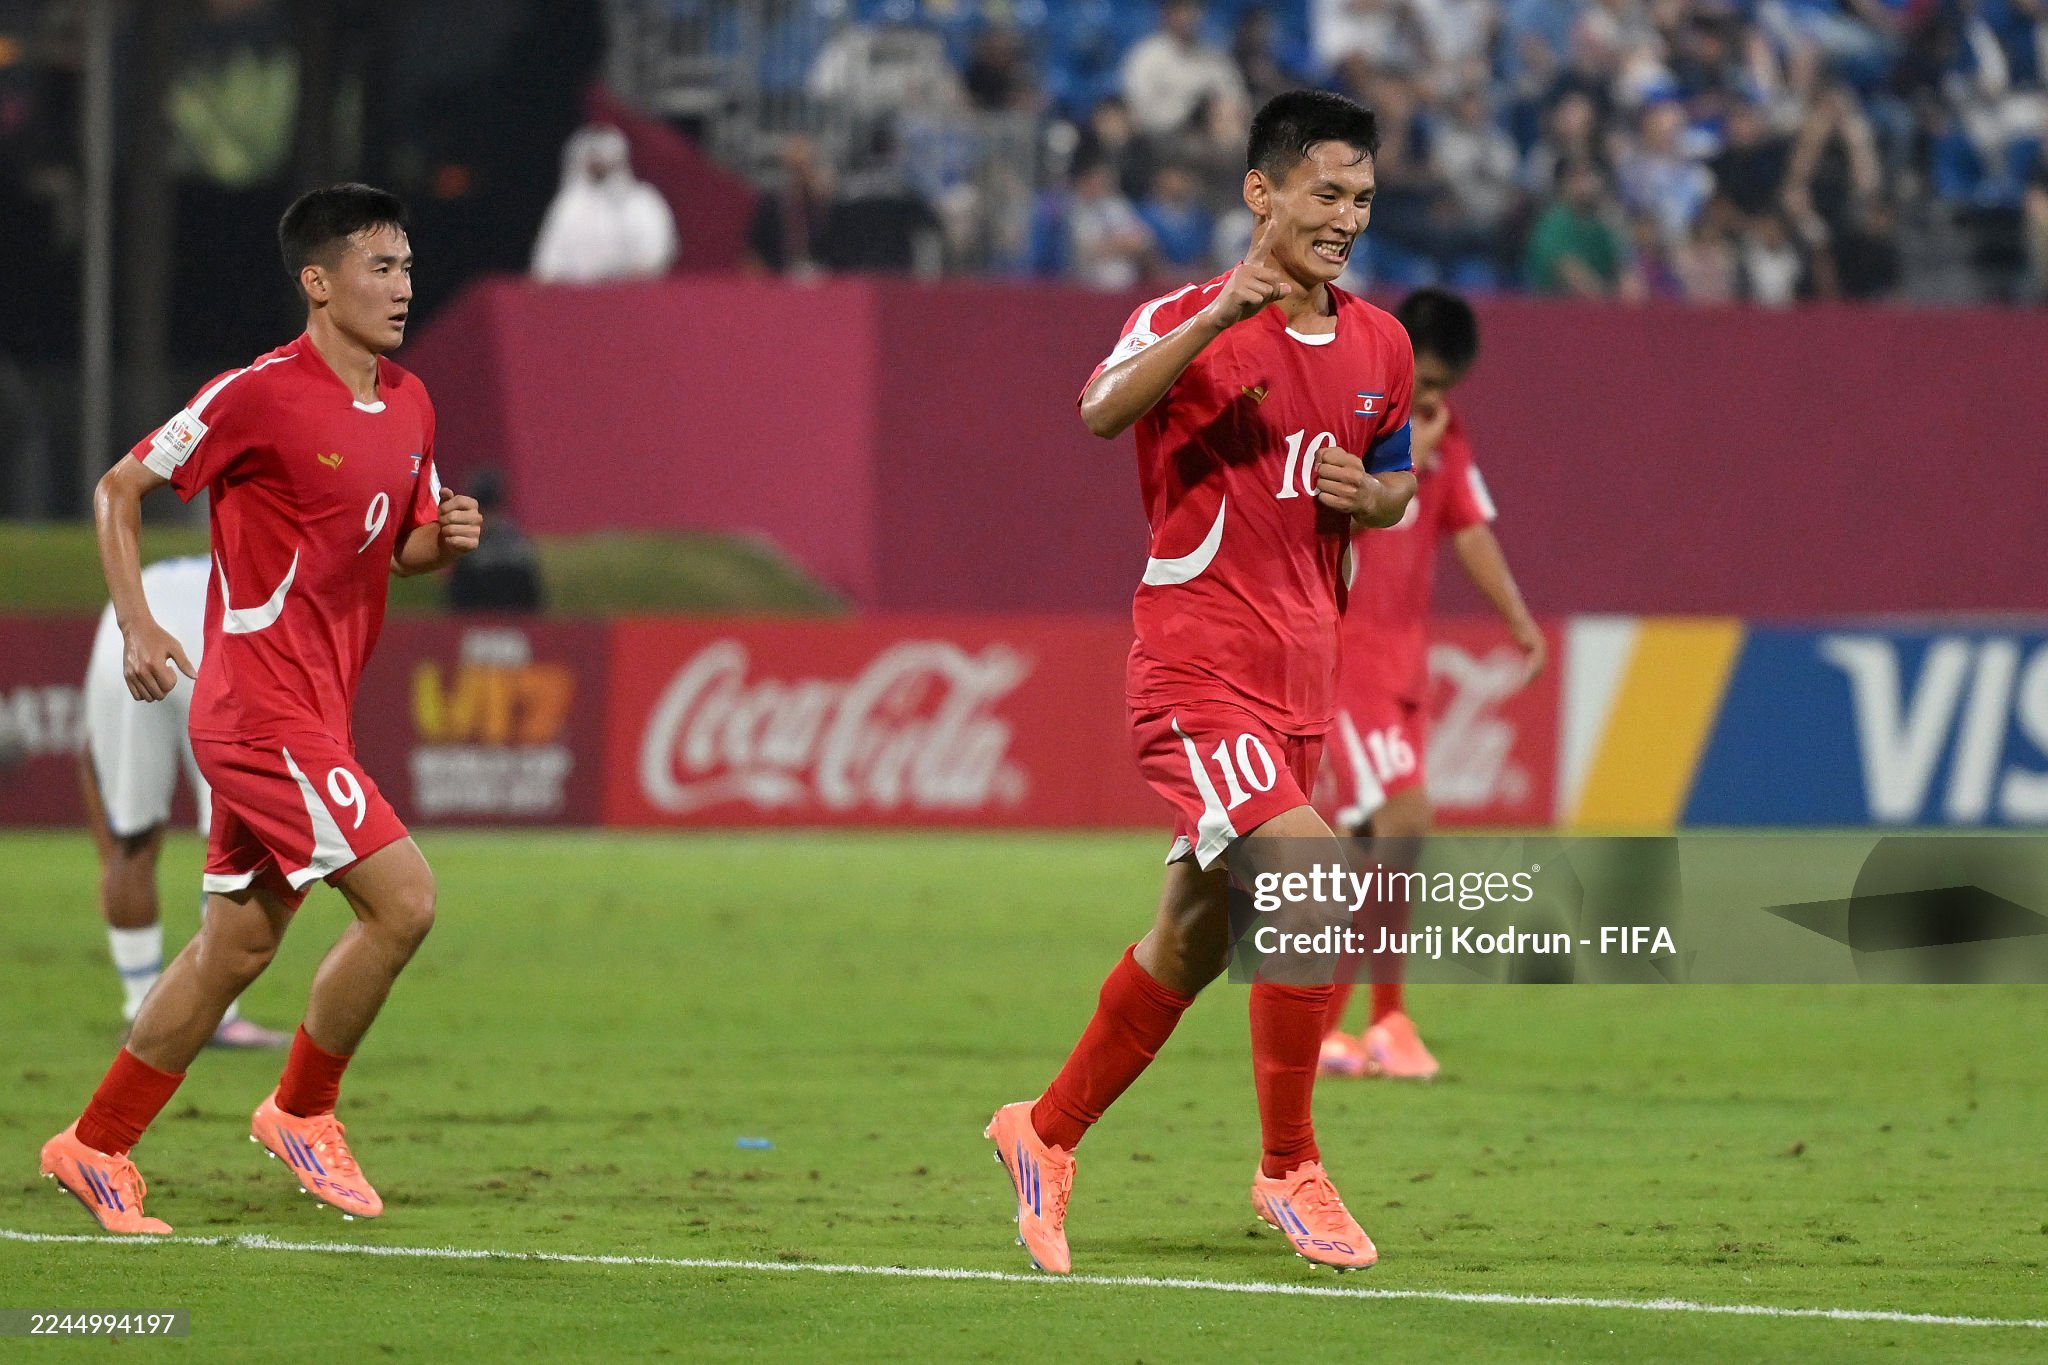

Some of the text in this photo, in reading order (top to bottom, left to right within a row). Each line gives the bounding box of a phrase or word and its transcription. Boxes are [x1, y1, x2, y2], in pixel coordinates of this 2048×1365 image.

[358, 492, 389, 554] 9
[639, 640, 1034, 813] Coca-Cola
[1366, 725, 1417, 782] 16
[326, 766, 366, 830] 9
[1211, 733, 1277, 811] 10
